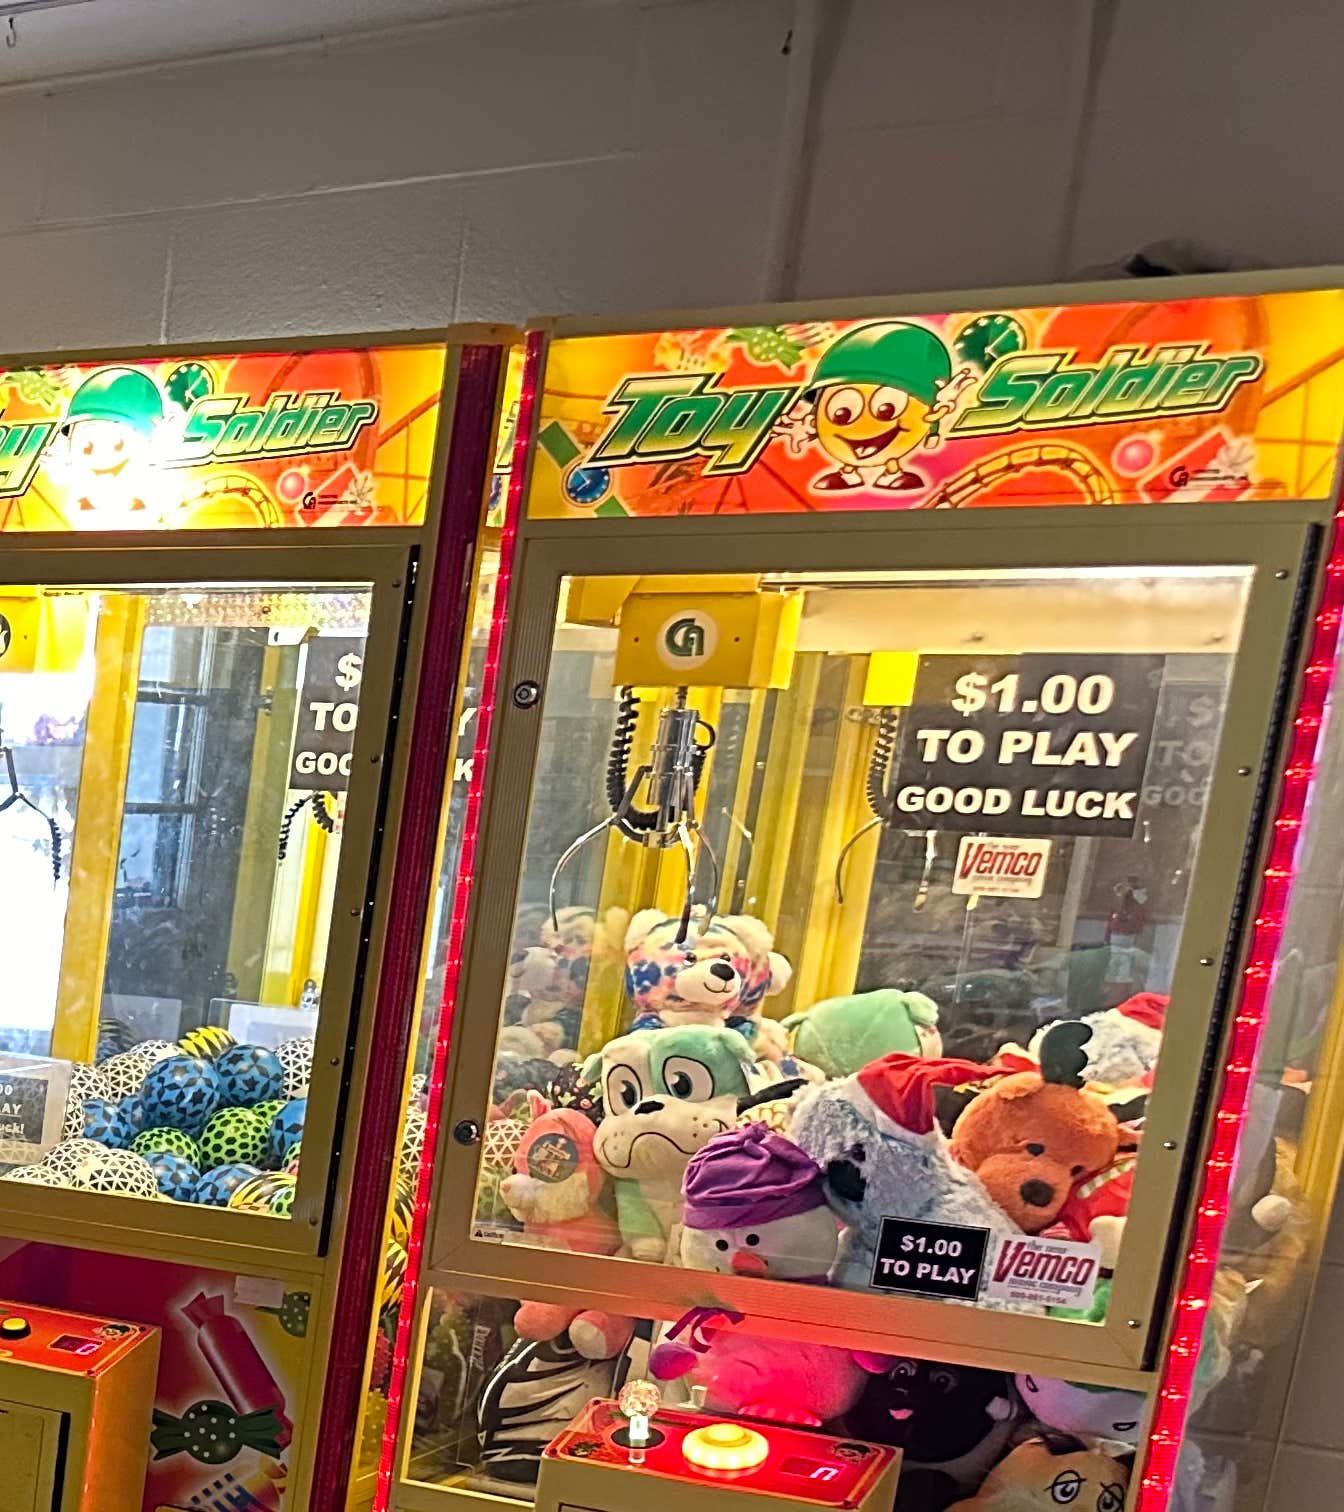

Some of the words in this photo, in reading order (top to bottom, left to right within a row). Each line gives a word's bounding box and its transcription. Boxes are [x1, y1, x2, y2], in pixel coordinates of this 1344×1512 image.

[587, 373, 804, 473] Toy
[952, 345, 1265, 438] Soldier
[174, 392, 379, 466] Soldier
[951, 672, 1114, 717] $1.00
[916, 730, 986, 764] TO
[998, 731, 1139, 767] PLAY
[896, 786, 1011, 815] GOOD
[1021, 790, 1137, 819] LUCK
[959, 843, 1043, 879] Vemco
[900, 1235, 962, 1257] $1.00
[992, 1239, 1095, 1286] Vemco
[880, 1258, 910, 1276] TO
[916, 1263, 976, 1285] PLAY
